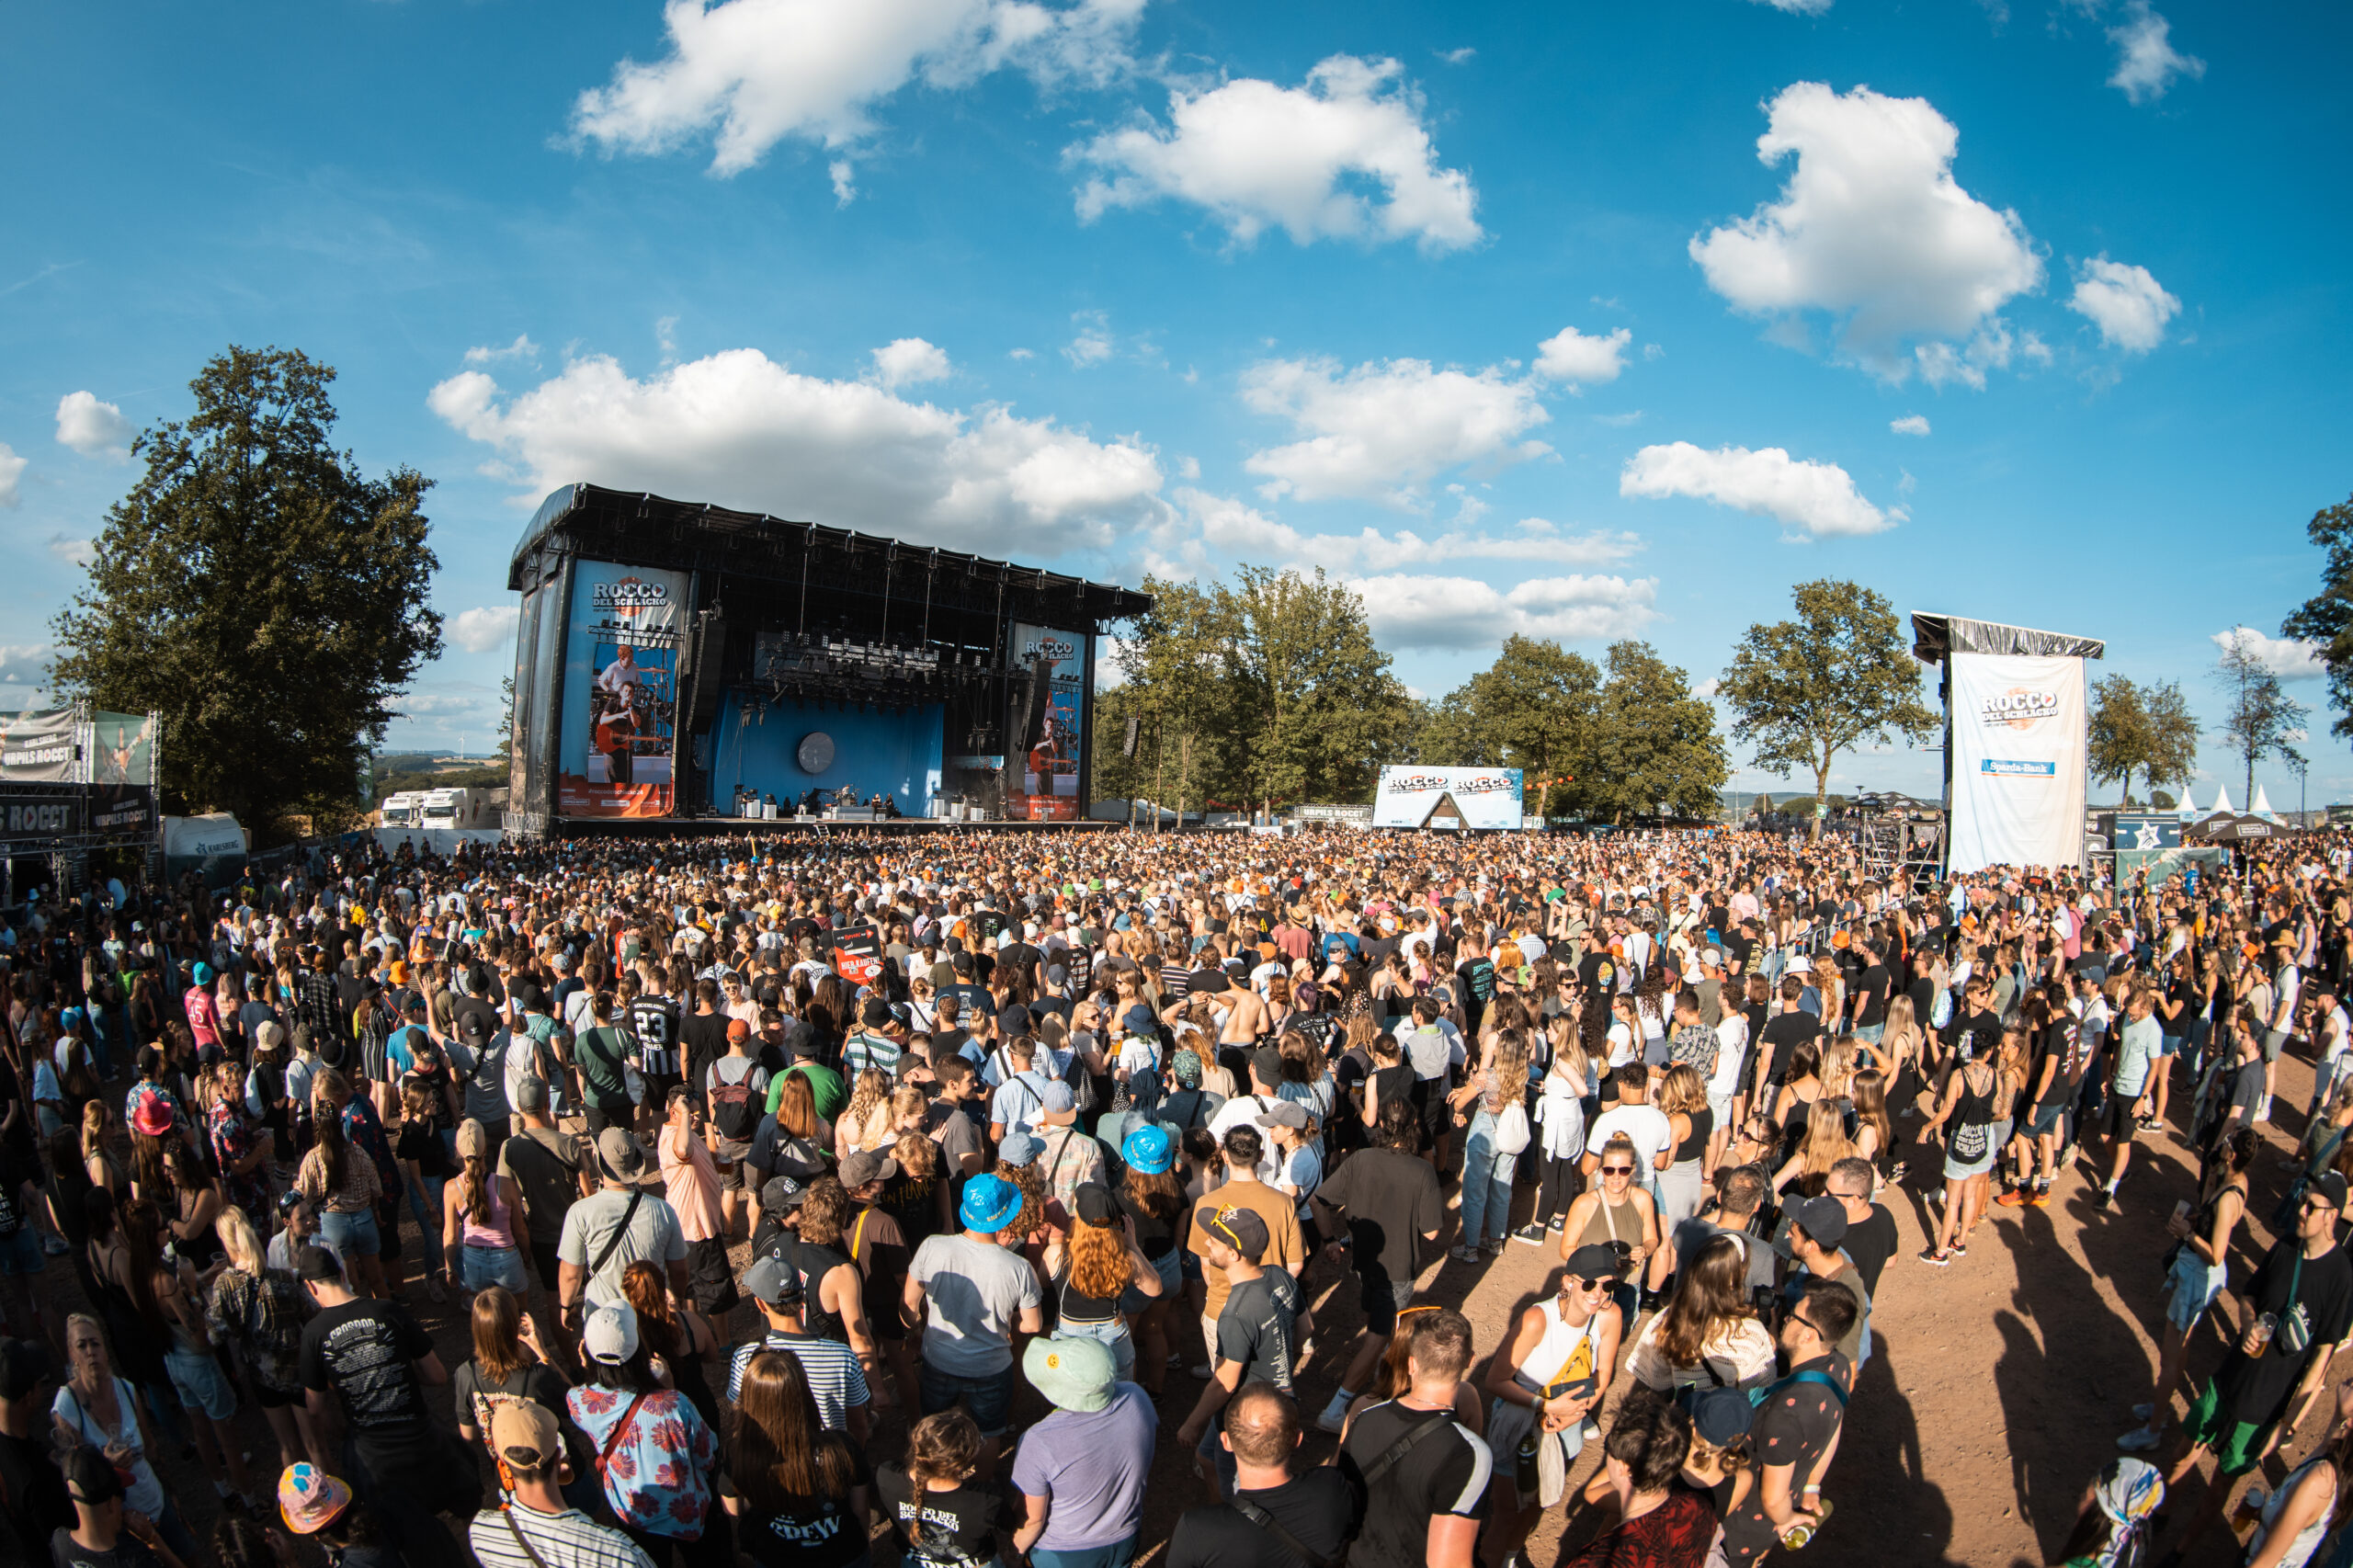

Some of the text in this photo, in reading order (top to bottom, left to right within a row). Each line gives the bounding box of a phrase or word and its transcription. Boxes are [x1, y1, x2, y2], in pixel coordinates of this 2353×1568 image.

[593, 583, 667, 598] ROCCO
[614, 598, 666, 607] SCHLACKO
[1982, 692, 2057, 712] ROCCO
[1983, 707, 2058, 722] DEL SCHLACKO
[24, 733, 57, 748] KARLSBERG
[4, 750, 36, 766] URPILS
[1990, 762, 2047, 773] Sparda-Bank
[1390, 777, 1448, 788] ROCCO
[1455, 778, 1513, 789] ROCCO
[96, 812, 124, 826] URPILS
[1303, 808, 1333, 817] URPILS
[209, 840, 239, 854] KARLSBERG
[841, 957, 881, 971] HIER KAUFEN!
[188, 1005, 204, 1023] 45
[634, 1011, 667, 1042] 23
[899, 1501, 960, 1523] ROCO DEL
[899, 1510, 960, 1532] SCLACKO
